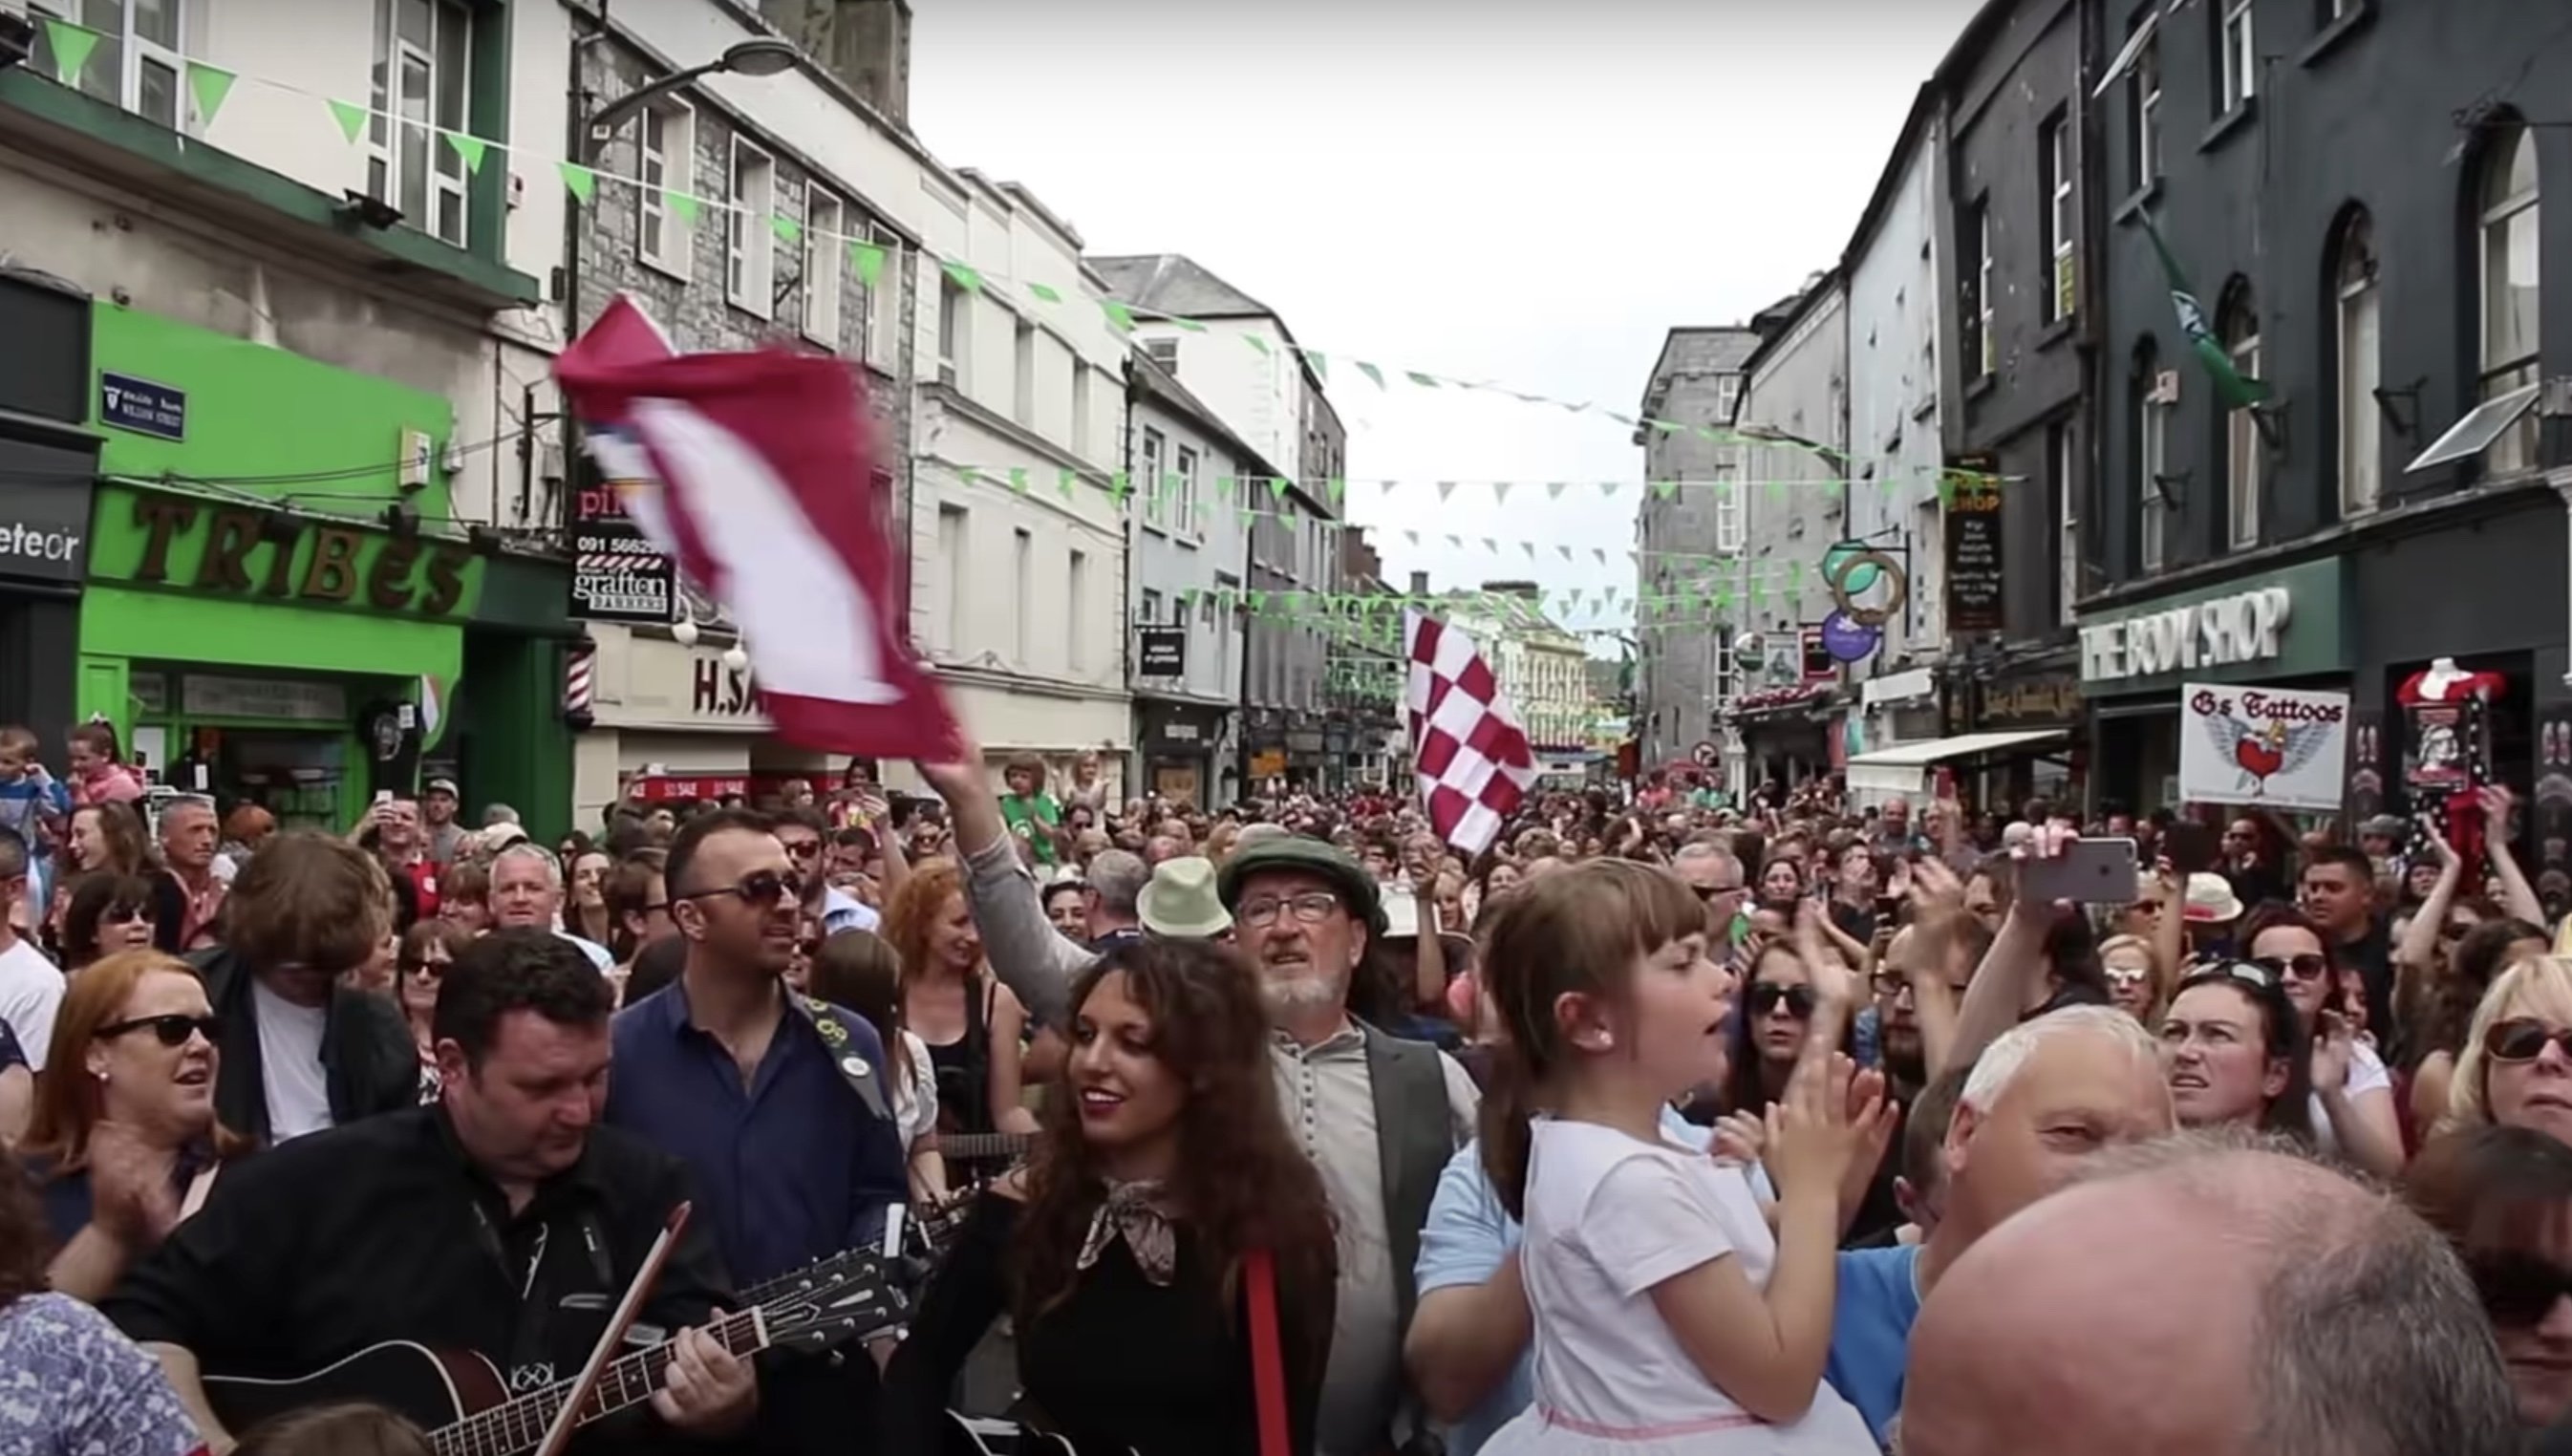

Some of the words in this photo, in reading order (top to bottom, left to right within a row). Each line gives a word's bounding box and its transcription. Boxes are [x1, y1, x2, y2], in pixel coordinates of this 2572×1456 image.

[0, 523, 79, 561] eteor
[577, 537, 606, 551] 091
[572, 568, 667, 600] grafton
[2079, 622, 2126, 681] THE
[2127, 606, 2200, 676] BODY
[2200, 588, 2290, 667] SHOP
[2242, 691, 2344, 722] Tattoos
